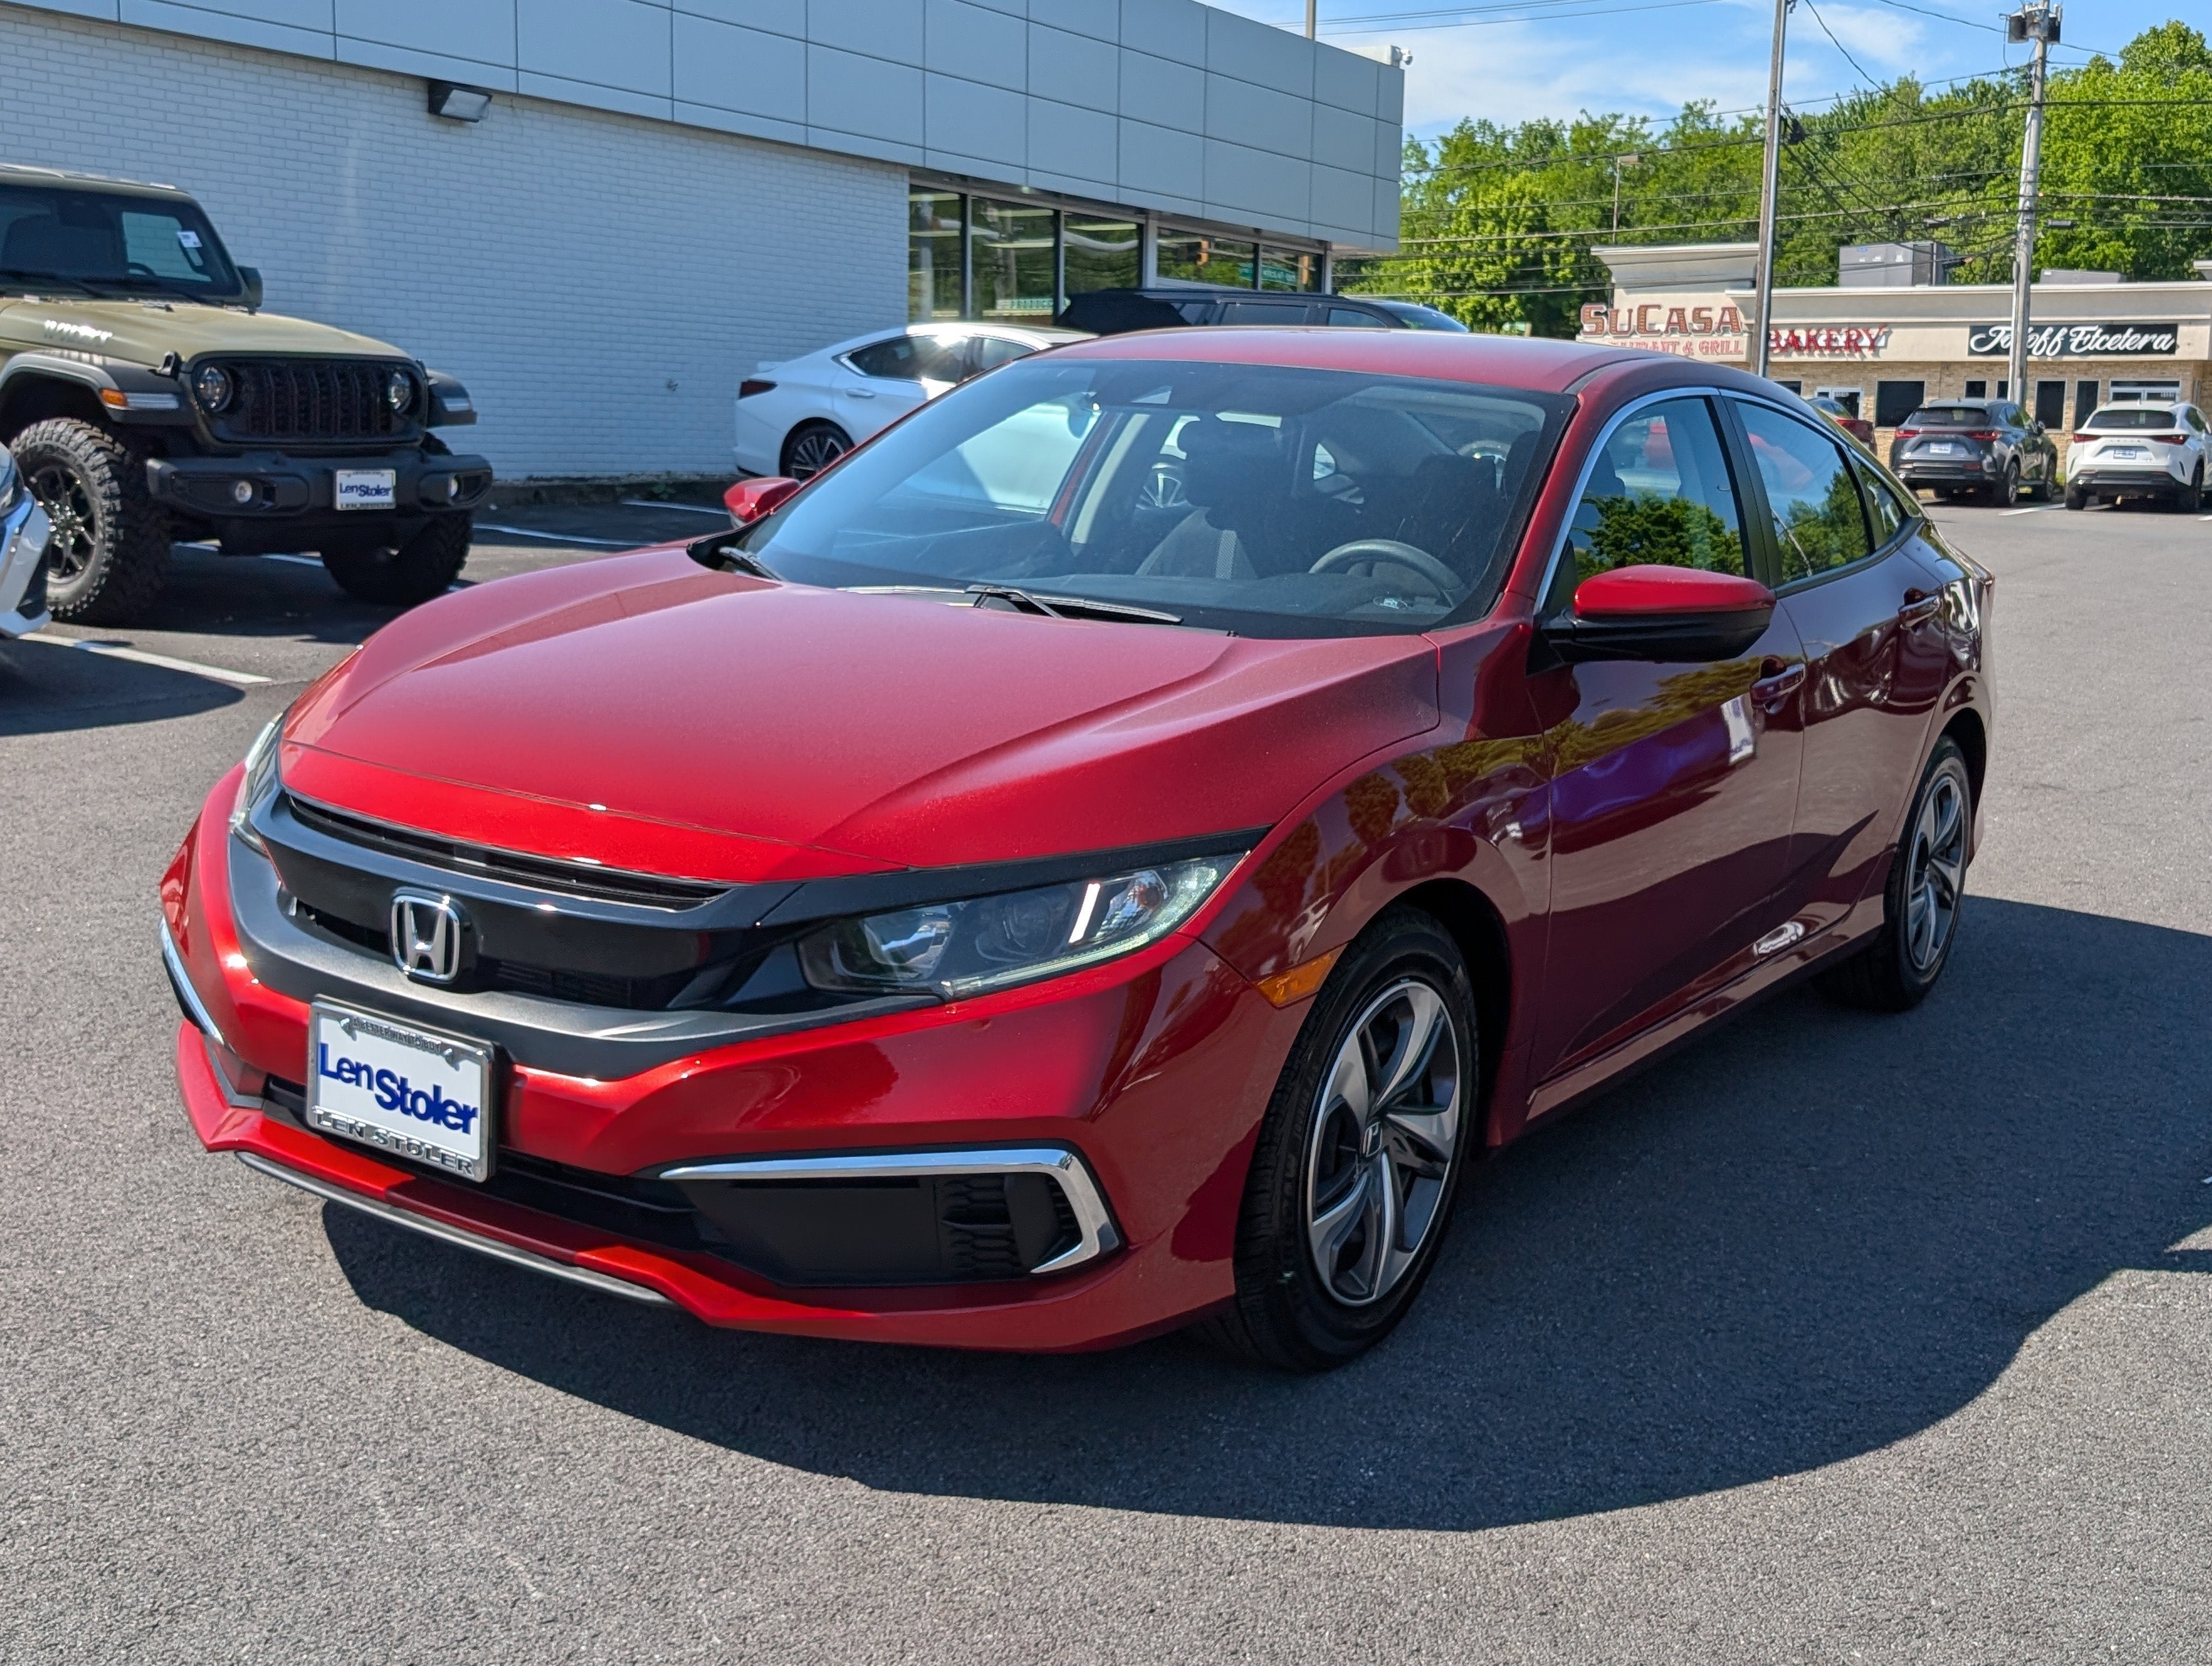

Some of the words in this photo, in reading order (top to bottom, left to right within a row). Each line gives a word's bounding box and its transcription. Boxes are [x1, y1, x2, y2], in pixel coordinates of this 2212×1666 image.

[1682, 341, 1694, 353] &
[1699, 340, 1743, 354] GRILL
[1970, 326, 2068, 356] Jooff
[2069, 325, 2176, 353] Etcetera
[372, 1129, 475, 1178] STOLER
